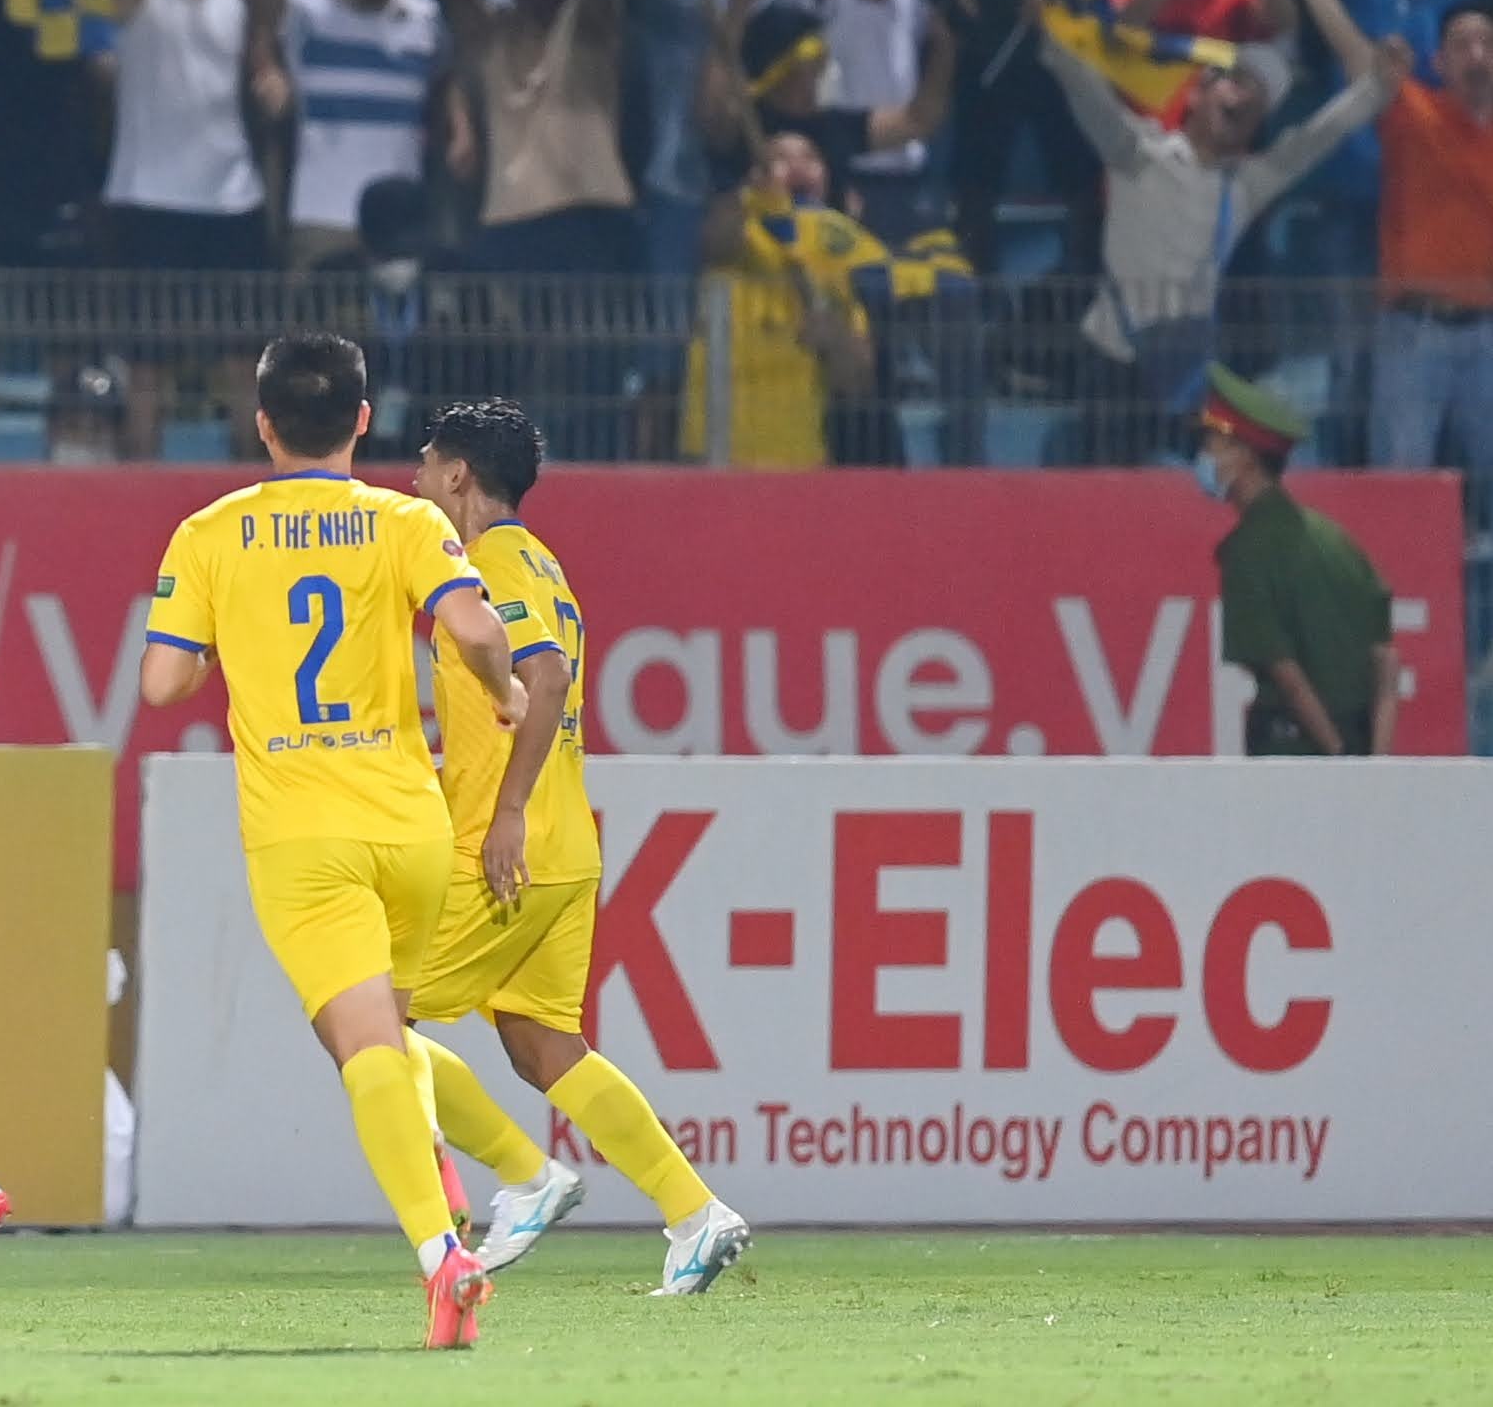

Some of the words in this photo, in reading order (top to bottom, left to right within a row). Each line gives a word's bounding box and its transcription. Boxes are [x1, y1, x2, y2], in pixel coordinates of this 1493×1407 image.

[241, 513, 265, 550] P.
[318, 505, 378, 551] NHẬT
[287, 574, 351, 725] 2
[581, 808, 1334, 1072] K-Elec
[756, 1100, 1063, 1182] Technology
[1079, 1099, 1332, 1183] Company
